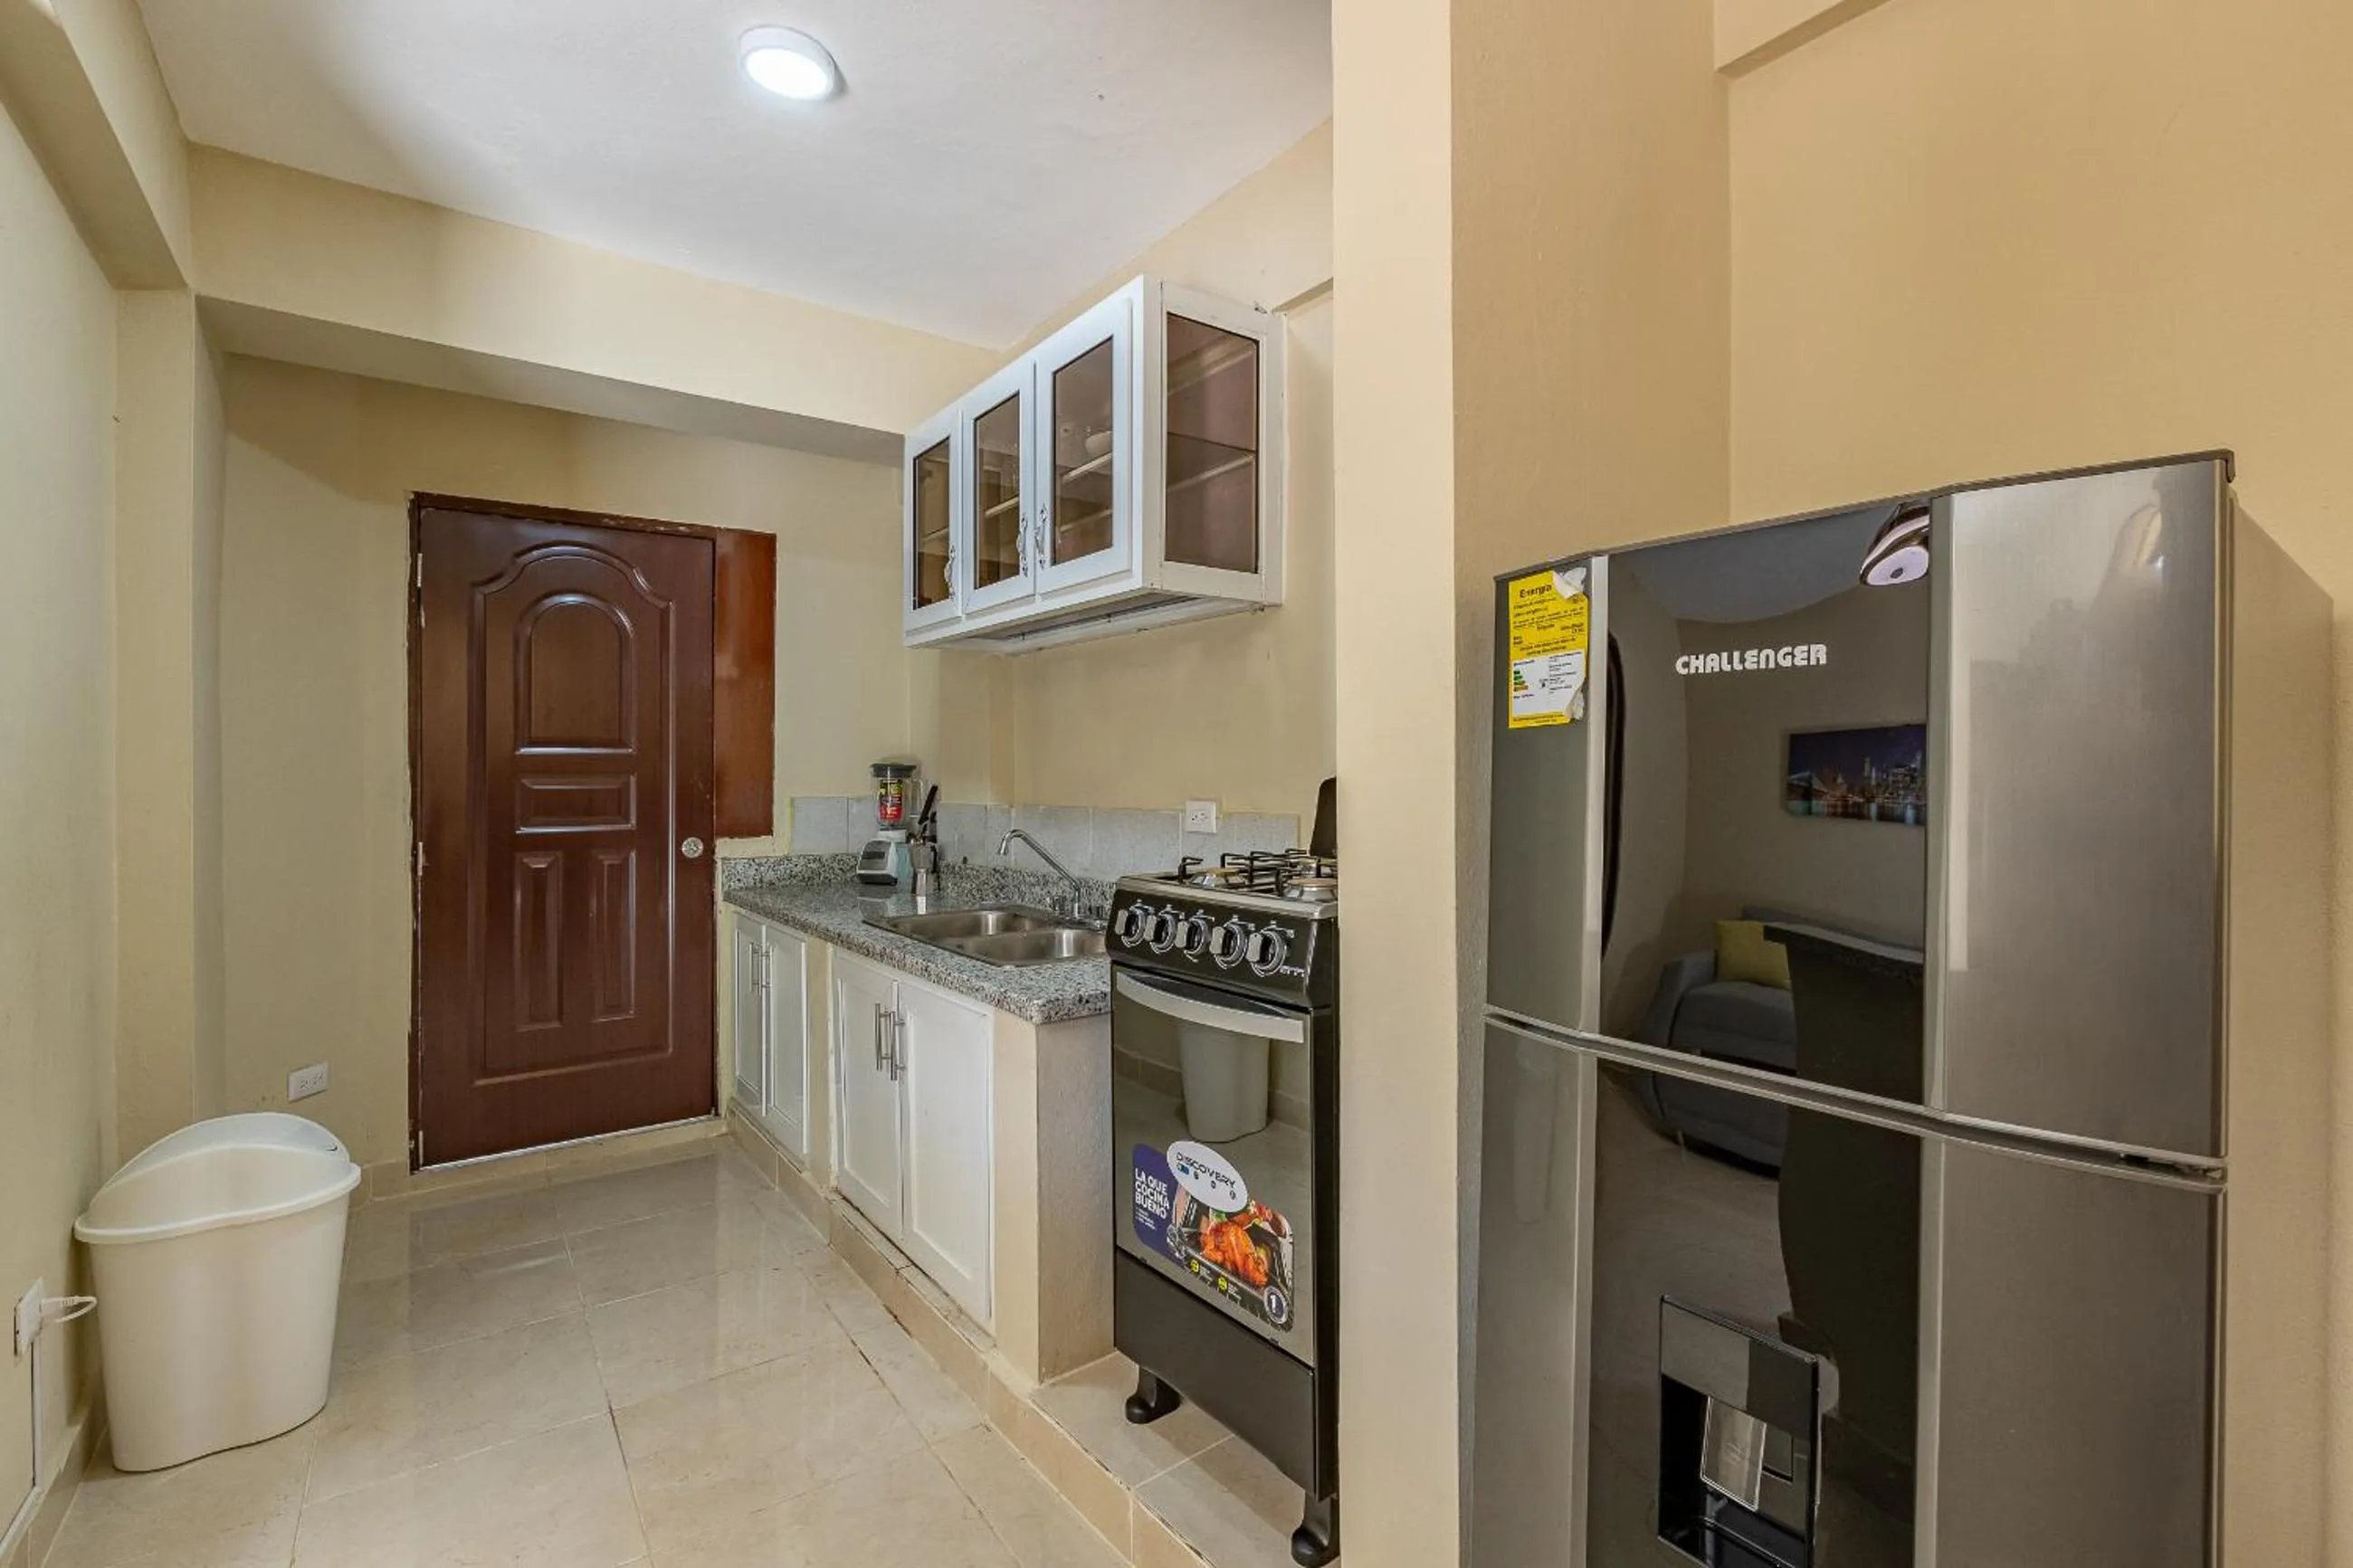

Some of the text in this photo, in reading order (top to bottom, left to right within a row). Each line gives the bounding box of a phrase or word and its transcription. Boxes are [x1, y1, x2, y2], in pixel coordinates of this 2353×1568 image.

[1675, 643, 1827, 675] CHALLENGER
[1135, 1168, 1167, 1194] LA QUE
[1176, 1152, 1236, 1188] DISCOVERY
[1135, 1181, 1169, 1210] COCINA
[1135, 1191, 1167, 1220] BUENO
